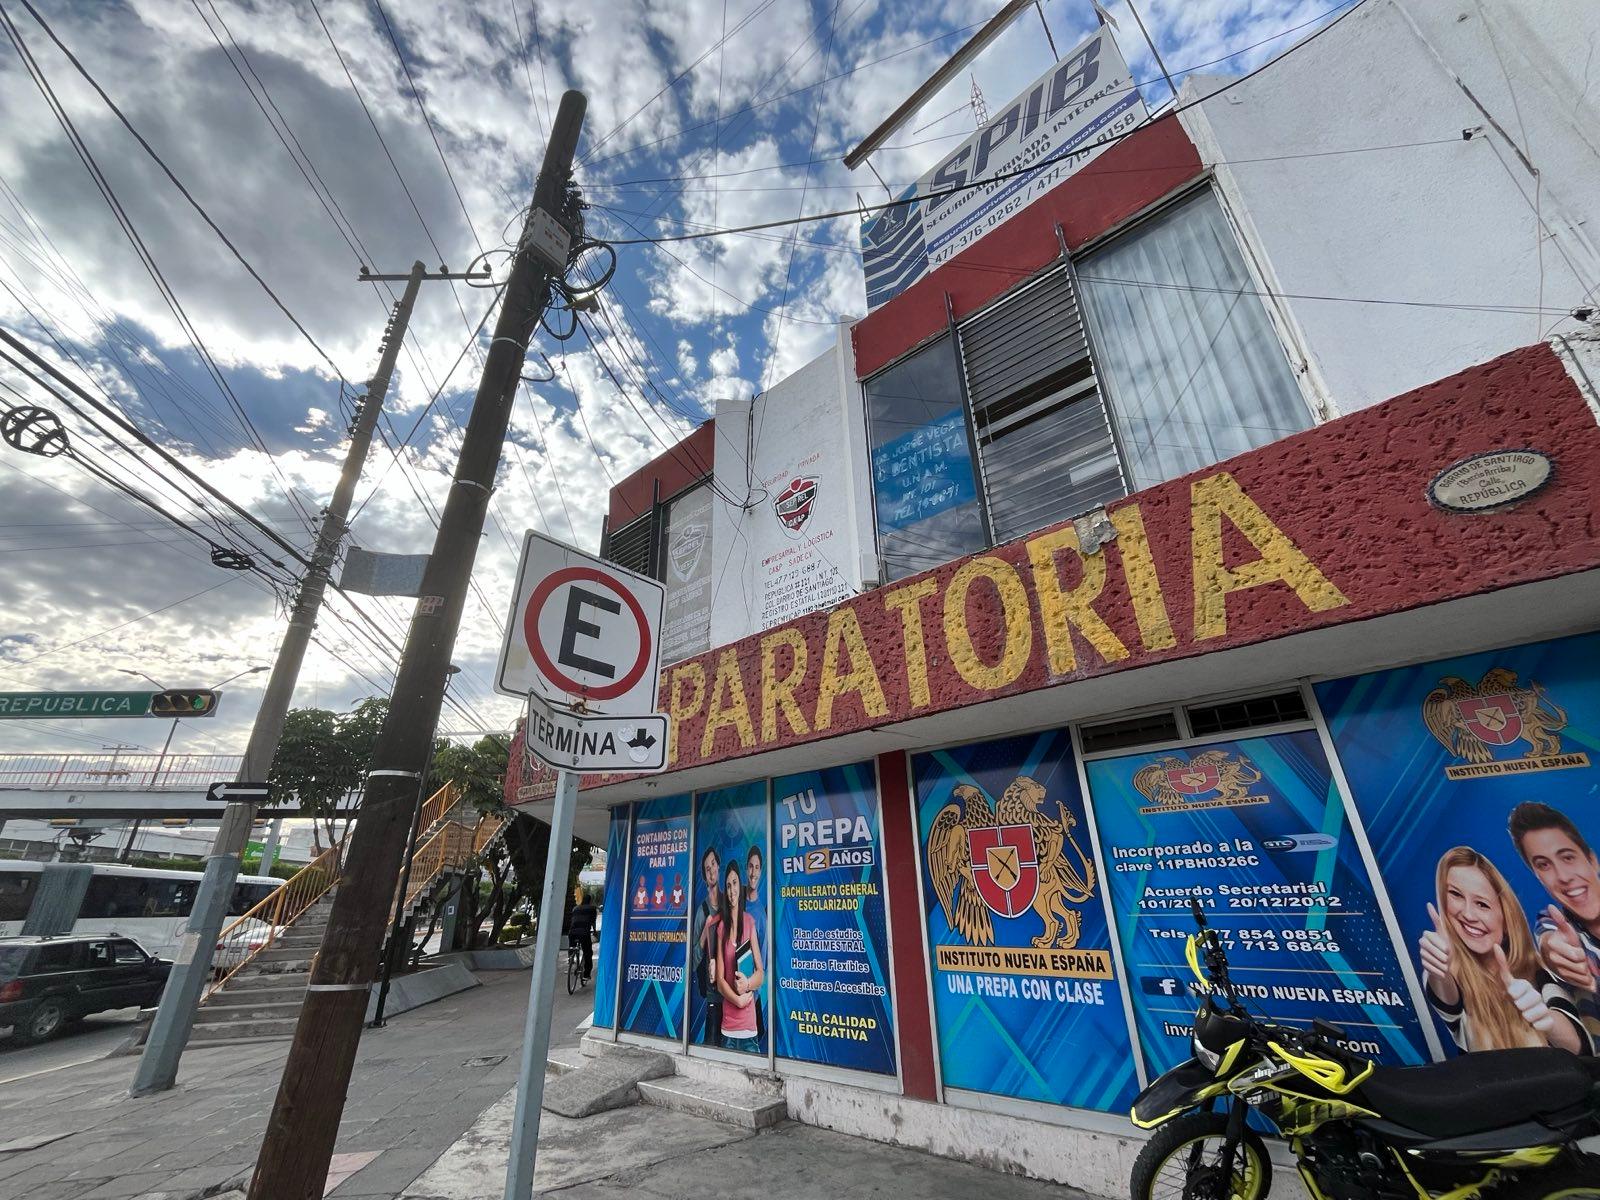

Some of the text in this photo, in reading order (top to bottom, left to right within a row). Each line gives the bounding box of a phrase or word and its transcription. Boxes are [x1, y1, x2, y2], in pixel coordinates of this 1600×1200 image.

[924, 36, 1101, 217] SPIB
[926, 181, 989, 231] SEGURIDAD
[994, 133, 1050, 177] PRIVADA
[1053, 79, 1122, 133] INTEGRAL
[935, 195, 1022, 265] 477-376-0262
[1439, 455, 1535, 488] BARRIO DE SANTIAGO
[791, 594, 816, 610] ESTATAL
[557, 585, 622, 679] E
[0, 696, 131, 713] REPUBLICA
[531, 709, 617, 756] TERMINA
[1449, 765, 1501, 777] INSTITUTO
[1504, 759, 1539, 771] NUEVA
[782, 789, 817, 820] TU
[1142, 802, 1189, 814] INSTITUTO
[1191, 801, 1224, 811] NUEVA
[637, 829, 688, 845] CONTAMOS CON
[782, 816, 872, 850] PREPA
[637, 842, 688, 857] BECAS IDEALES
[1112, 838, 1253, 860] Incorporado a la
[649, 856, 675, 868] PARA TI
[783, 850, 872, 874] EN 2 AÑOS
[1115, 855, 1260, 872] clave 11PBH0326C
[781, 883, 879, 898] BACHILLERATO GENERAL
[1144, 881, 1327, 897] Acuerdo Secretarial
[799, 898, 859, 911] ESCOLARIZADO
[1137, 896, 1342, 909] 101/2011 20/12/2012
[793, 928, 863, 940] Plan de estudios
[1238, 929, 1276, 940] 854
[1282, 929, 1333, 940] 0851
[793, 940, 866, 952] CUATRIMESTRAL
[1242, 940, 1280, 951] 713
[1287, 940, 1340, 952] 6846
[791, 958, 870, 973] Horarios Flexibles
[940, 950, 1106, 973] INSTITUTO NUEVA ESPAÑA
[780, 978, 886, 997] Colegiaturas Accesibles
[947, 974, 1104, 1006] UNA PREPA CON CLASE
[1272, 984, 1330, 1003] NUEVA
[1333, 986, 1405, 1007] ESPAÑA
[790, 1010, 877, 1030] ALTA CALIDAD
[798, 1023, 869, 1042] EDUCATIVA
